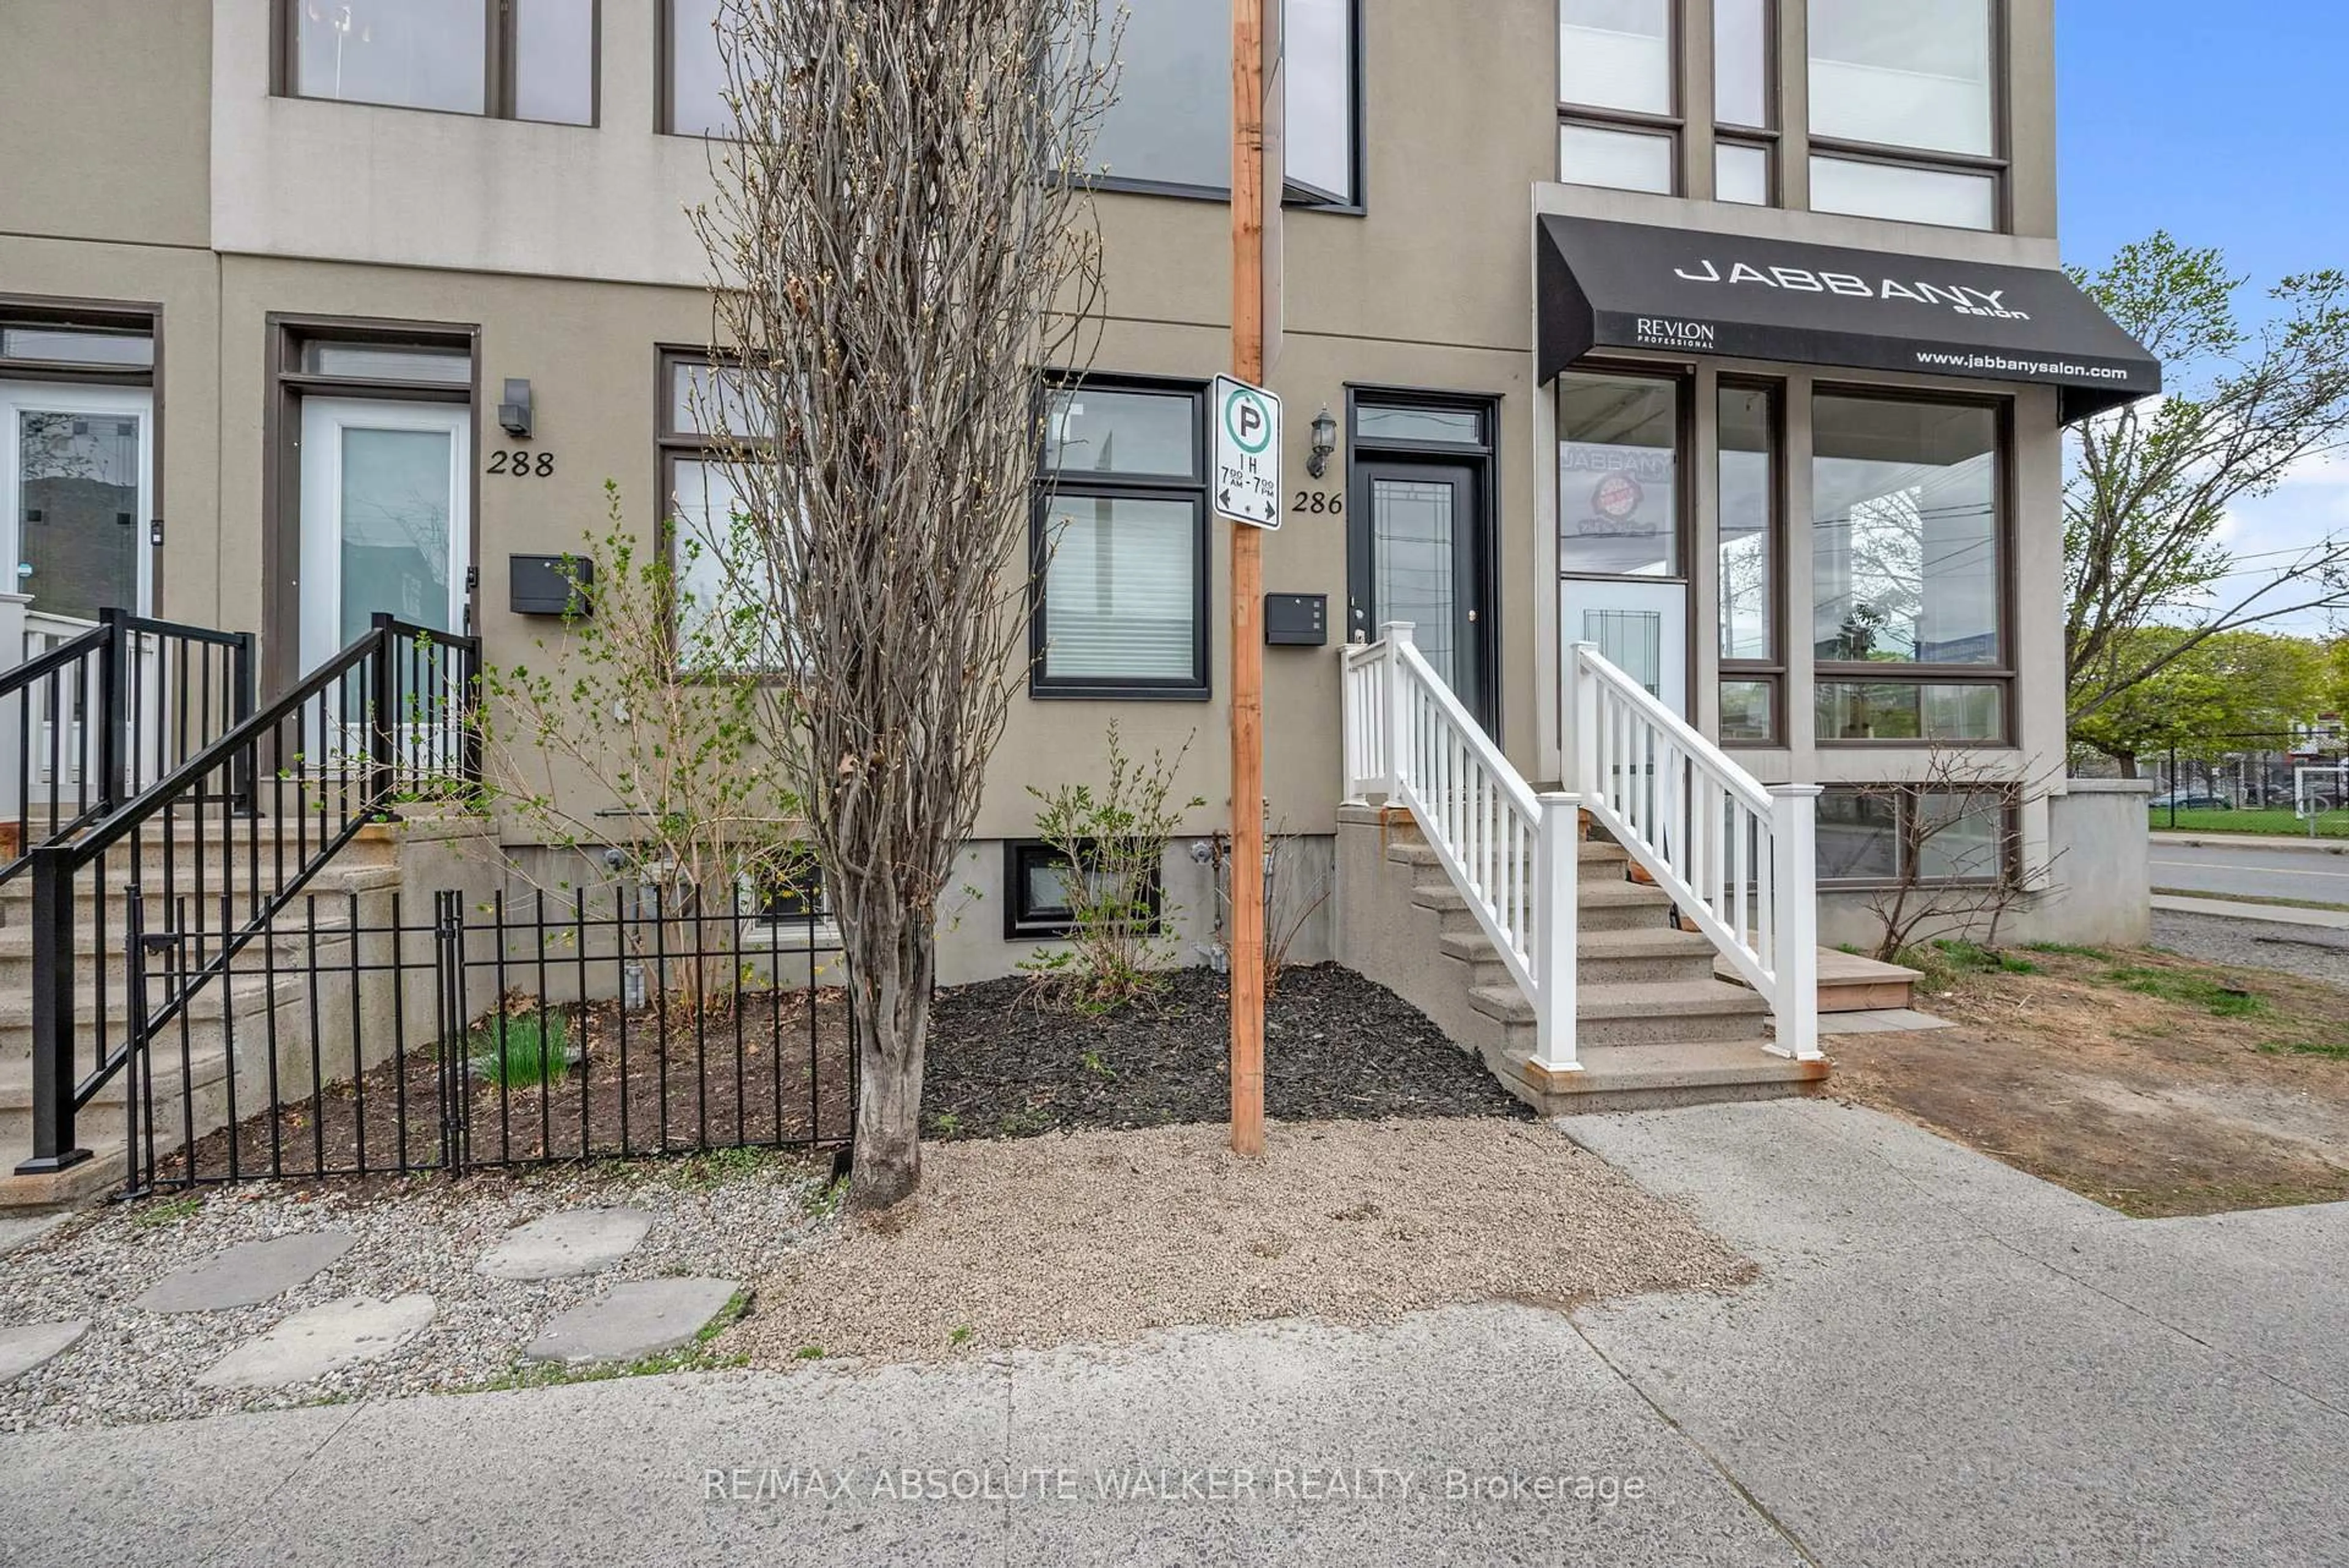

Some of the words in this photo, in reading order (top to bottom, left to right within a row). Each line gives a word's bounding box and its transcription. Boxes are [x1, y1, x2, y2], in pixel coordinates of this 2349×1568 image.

[1674, 259, 2004, 311] JABBANY
[1953, 305, 2030, 320] salon
[1638, 318, 1714, 340] REVLON
[1638, 335, 1714, 349] PROFESSIONAL
[1917, 352, 2127, 380] www.jabbanysalon.com
[1241, 405, 1261, 437] P
[486, 450, 554, 478] 288
[1292, 491, 1342, 514] 286
